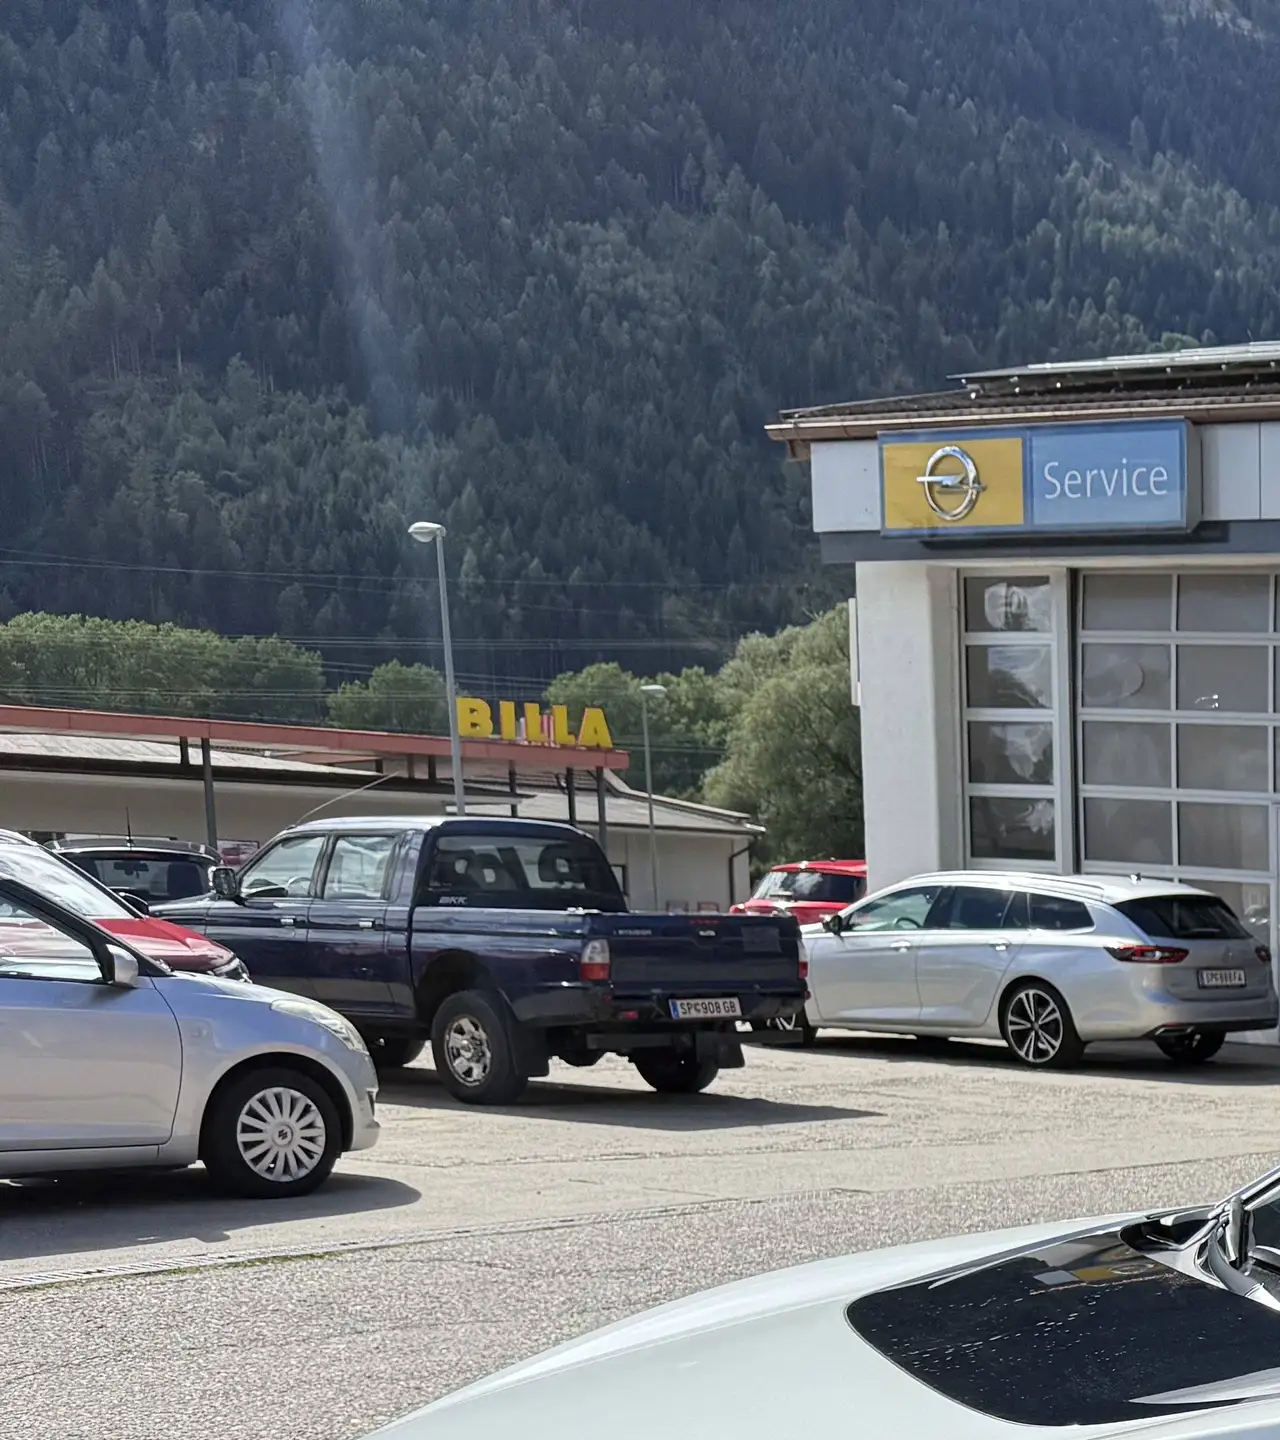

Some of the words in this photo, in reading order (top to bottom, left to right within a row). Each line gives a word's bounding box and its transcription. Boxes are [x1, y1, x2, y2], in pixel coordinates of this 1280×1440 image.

[1043, 457, 1169, 500] Service
[455, 695, 614, 749] BILLA
[680, 1002, 696, 1015] SP
[701, 1001, 722, 1015] 908
[723, 1000, 737, 1014] GB
